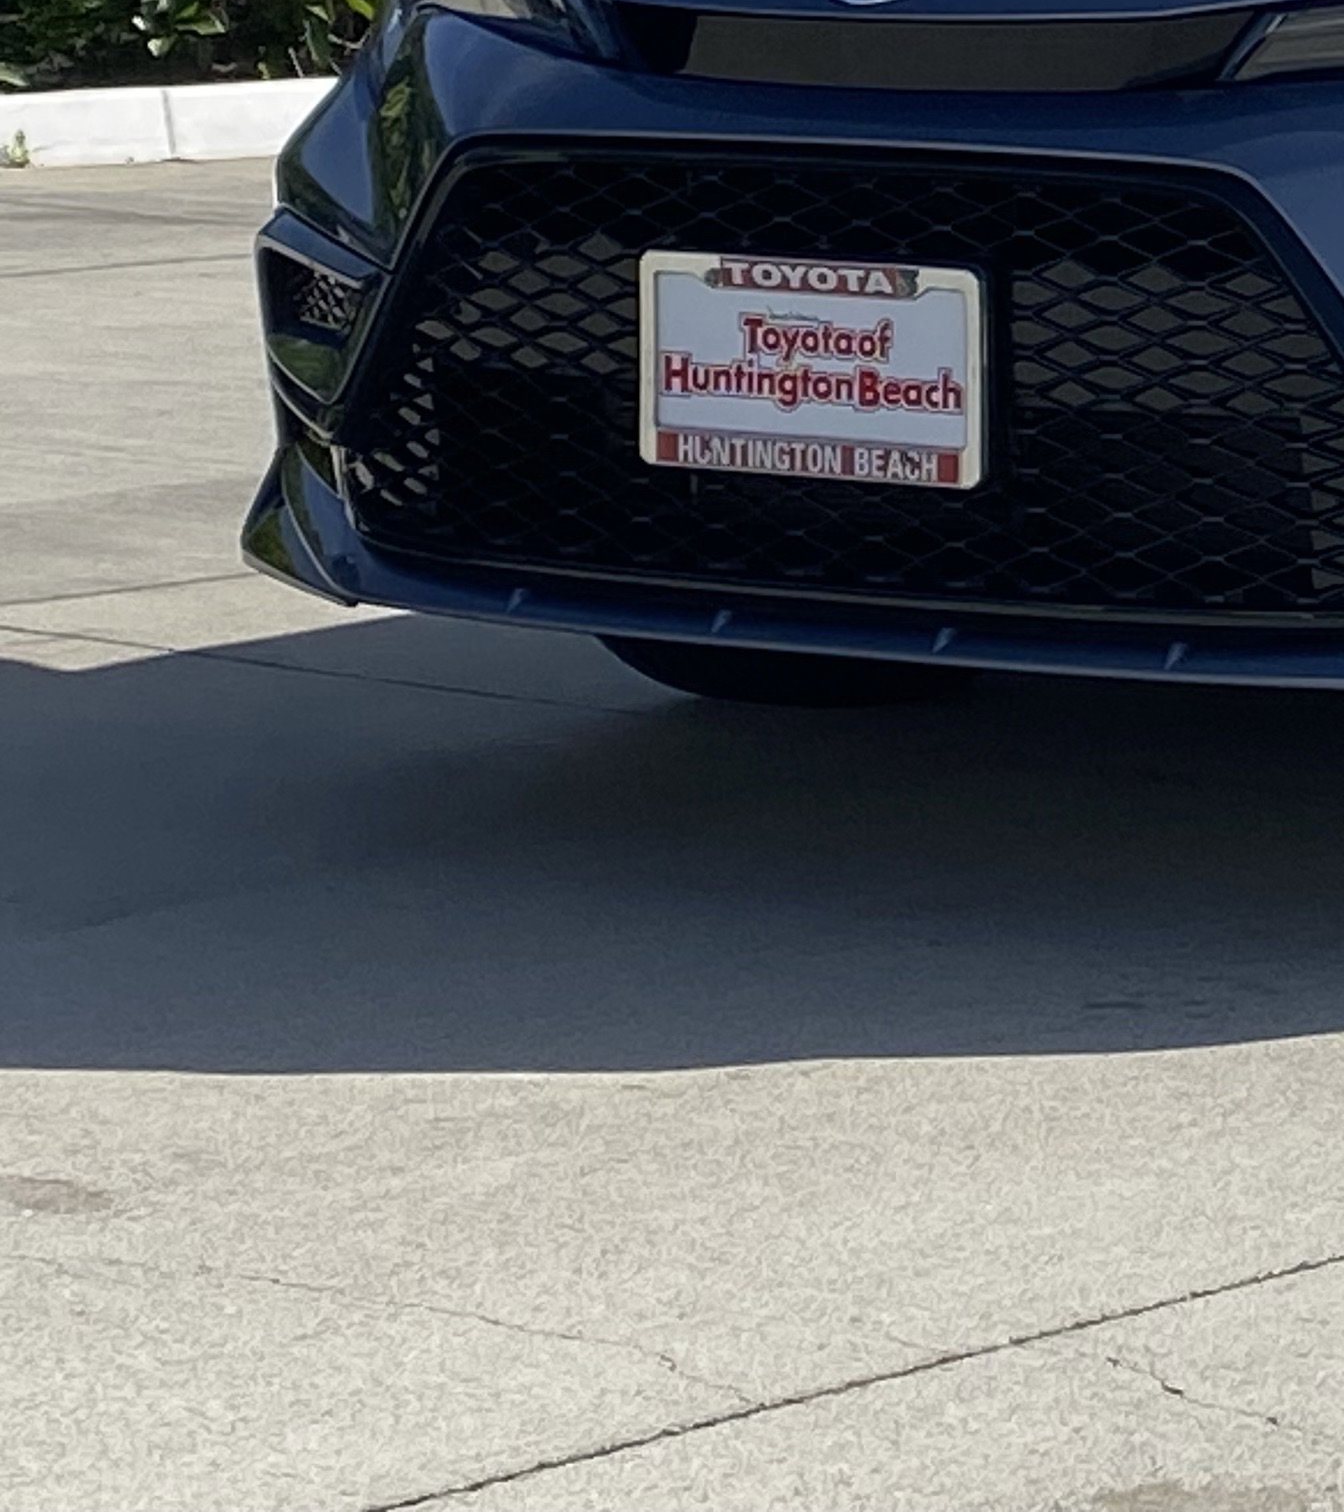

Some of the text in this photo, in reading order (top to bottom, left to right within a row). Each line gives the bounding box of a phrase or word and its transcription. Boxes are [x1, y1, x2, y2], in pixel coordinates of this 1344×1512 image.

[729, 262, 895, 293] TOYOTA
[742, 316, 857, 361] Toyota
[662, 354, 964, 410] Huntington Beach
[677, 434, 939, 482] HUNTINGTON BEACH
